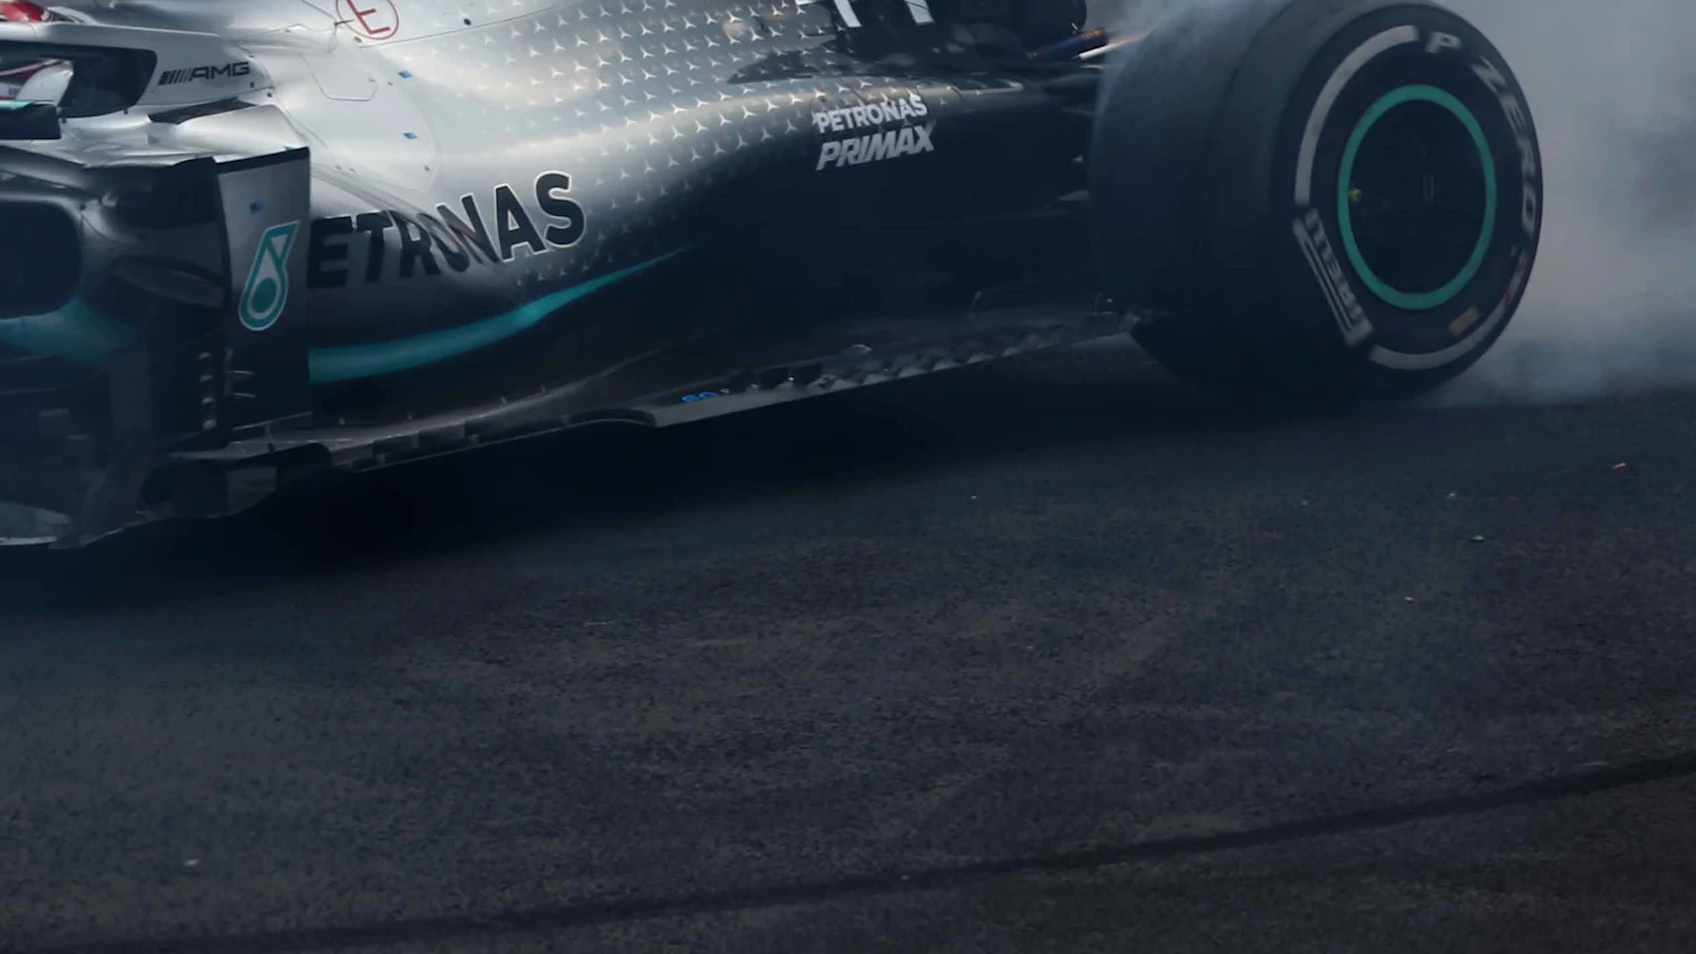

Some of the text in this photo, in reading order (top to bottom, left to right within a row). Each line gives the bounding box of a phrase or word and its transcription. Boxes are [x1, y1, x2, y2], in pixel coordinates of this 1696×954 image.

[192, 61, 250, 80] AMG
[814, 94, 928, 134] PETRONAS
[1424, 30, 1536, 242] P ZERO
[815, 121, 936, 172] PRIMAX
[307, 169, 586, 289] ETRONAS
